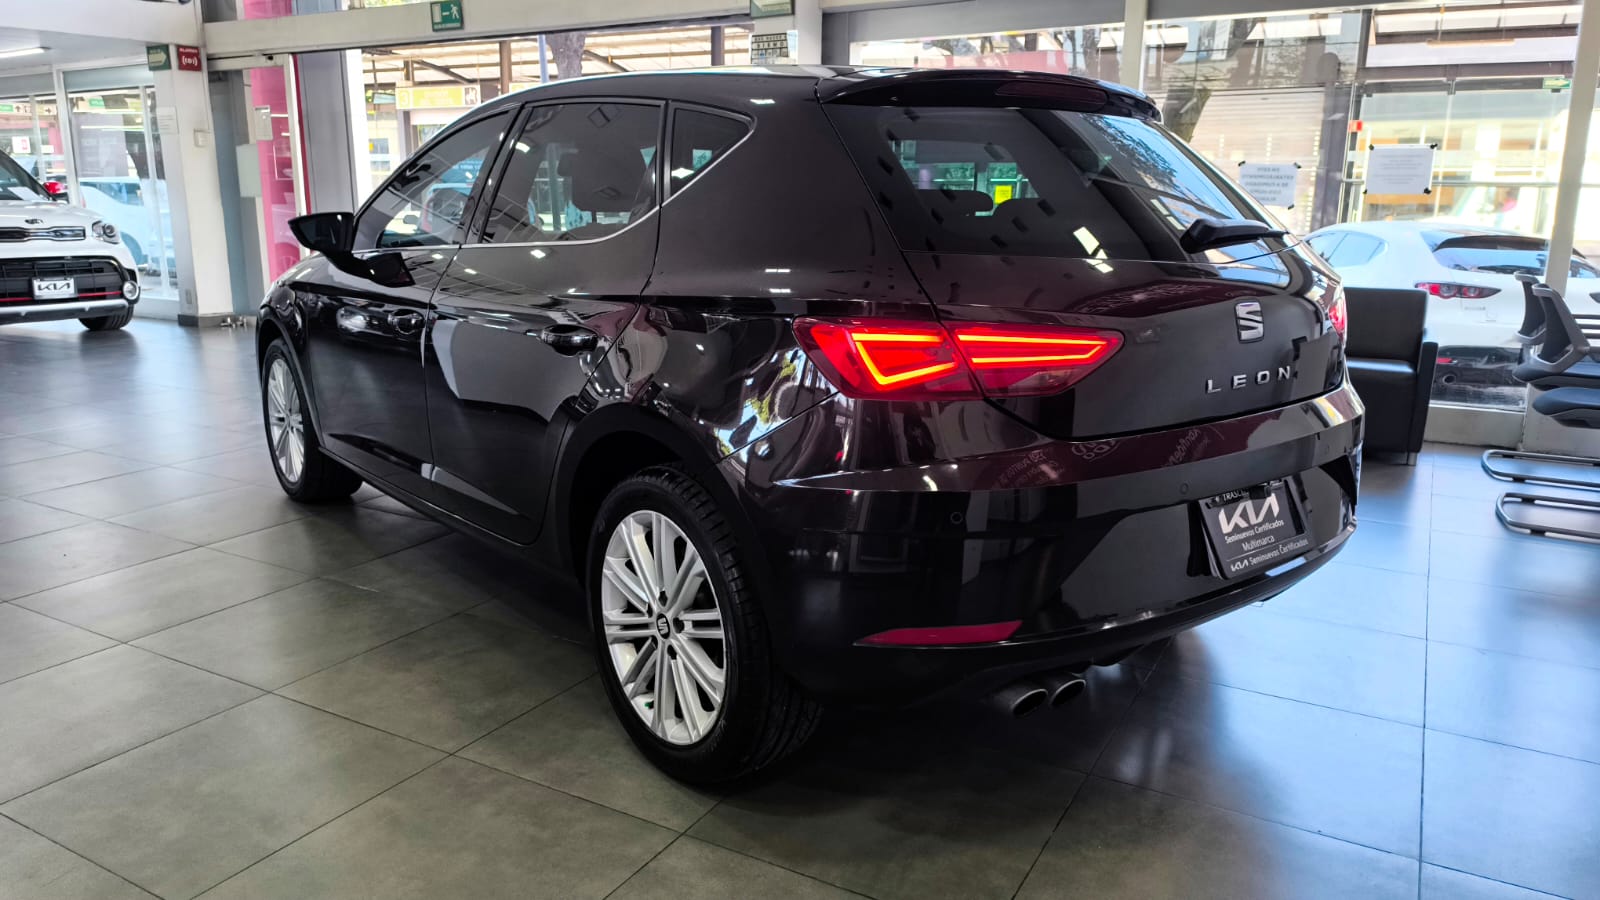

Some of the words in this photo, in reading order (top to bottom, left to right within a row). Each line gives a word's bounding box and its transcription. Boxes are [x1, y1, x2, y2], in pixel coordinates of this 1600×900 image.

[38, 282, 71, 291] KIA
[1207, 366, 1291, 394] LEON
[1218, 492, 1280, 534] KIA
[1224, 529, 1255, 544] Seminuevos
[1254, 519, 1285, 534] Certificados
[1241, 535, 1275, 551] Multimarca
[1230, 559, 1249, 572] KIA
[1249, 549, 1280, 565] Seminuevos
[1278, 538, 1309, 554] Certificados
